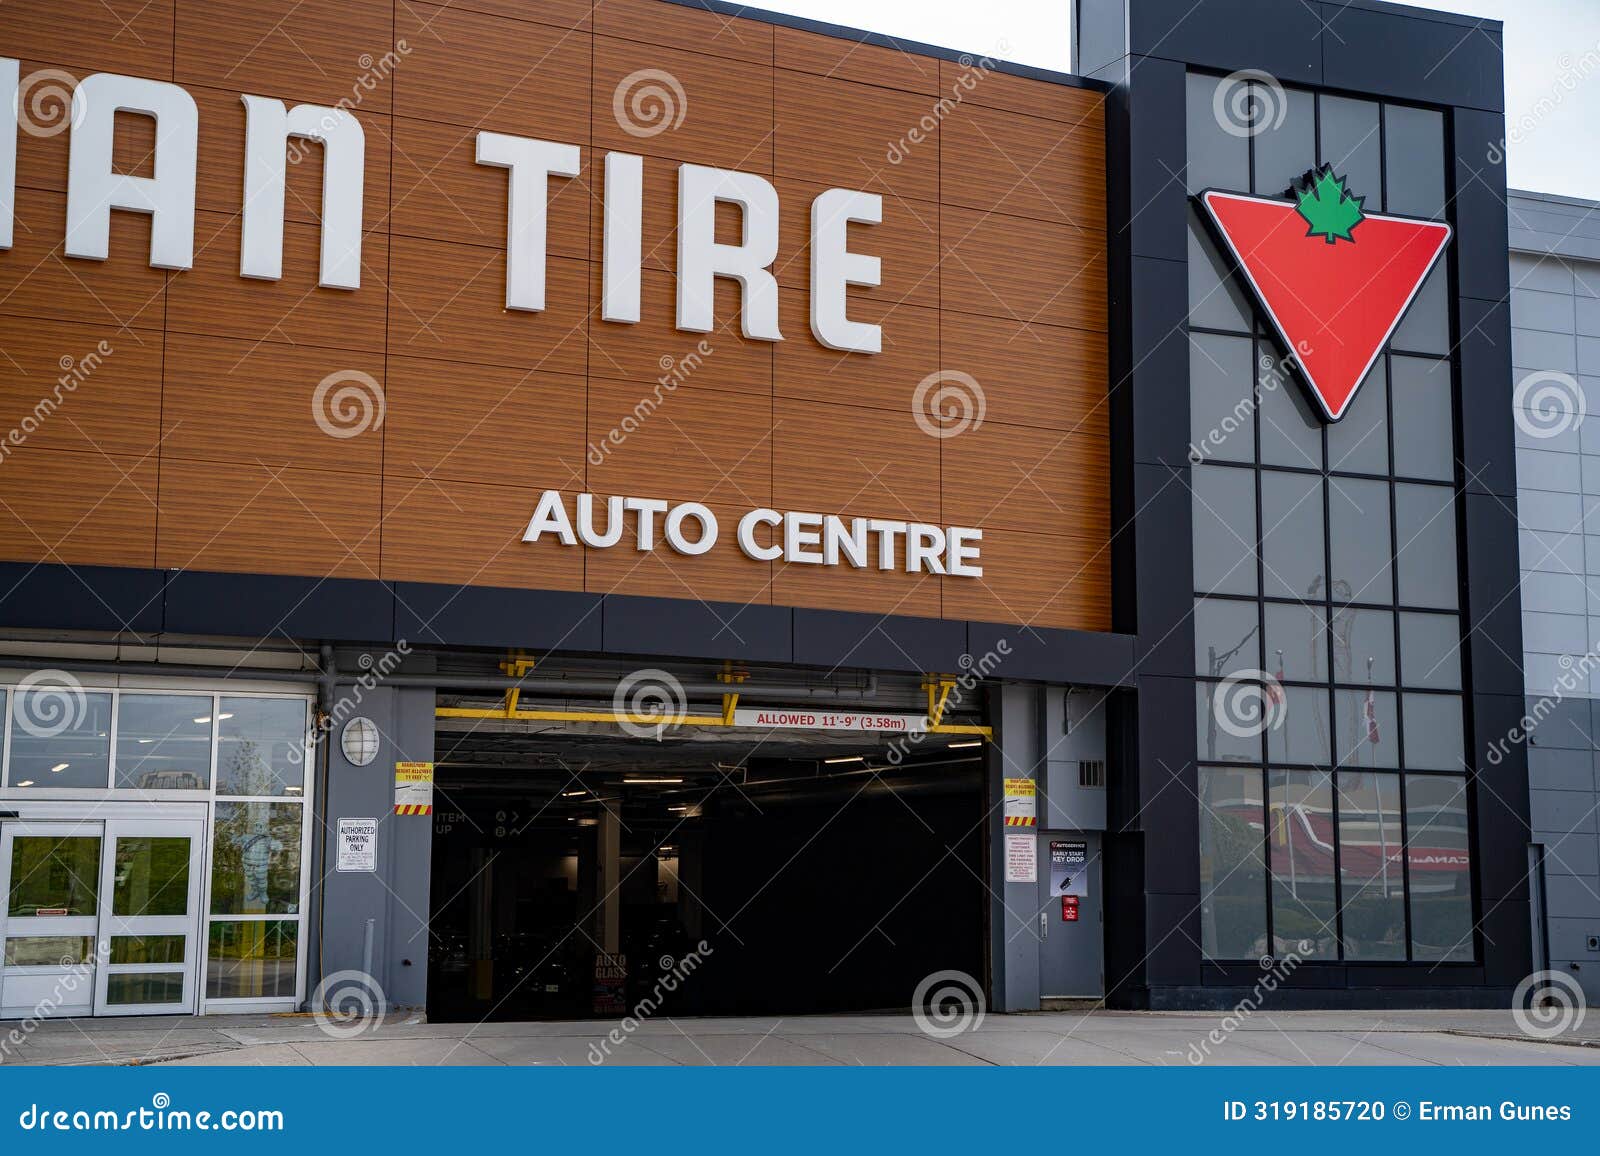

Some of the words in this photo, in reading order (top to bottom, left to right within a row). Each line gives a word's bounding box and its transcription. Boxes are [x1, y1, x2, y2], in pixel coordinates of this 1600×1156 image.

[475, 130, 883, 355] TIRE
[521, 490, 719, 556] AUTO
[737, 508, 984, 578] CENTRE
[757, 713, 816, 726] ALLOWED
[822, 715, 857, 727] 11'-9"
[860, 716, 907, 731] (3.58m)
[340, 826, 375, 835] AUTHORIZED
[345, 835, 369, 843] PARKING
[349, 843, 364, 852] ONLY
[595, 954, 627, 967] AUTO
[595, 967, 627, 979] GLASS
